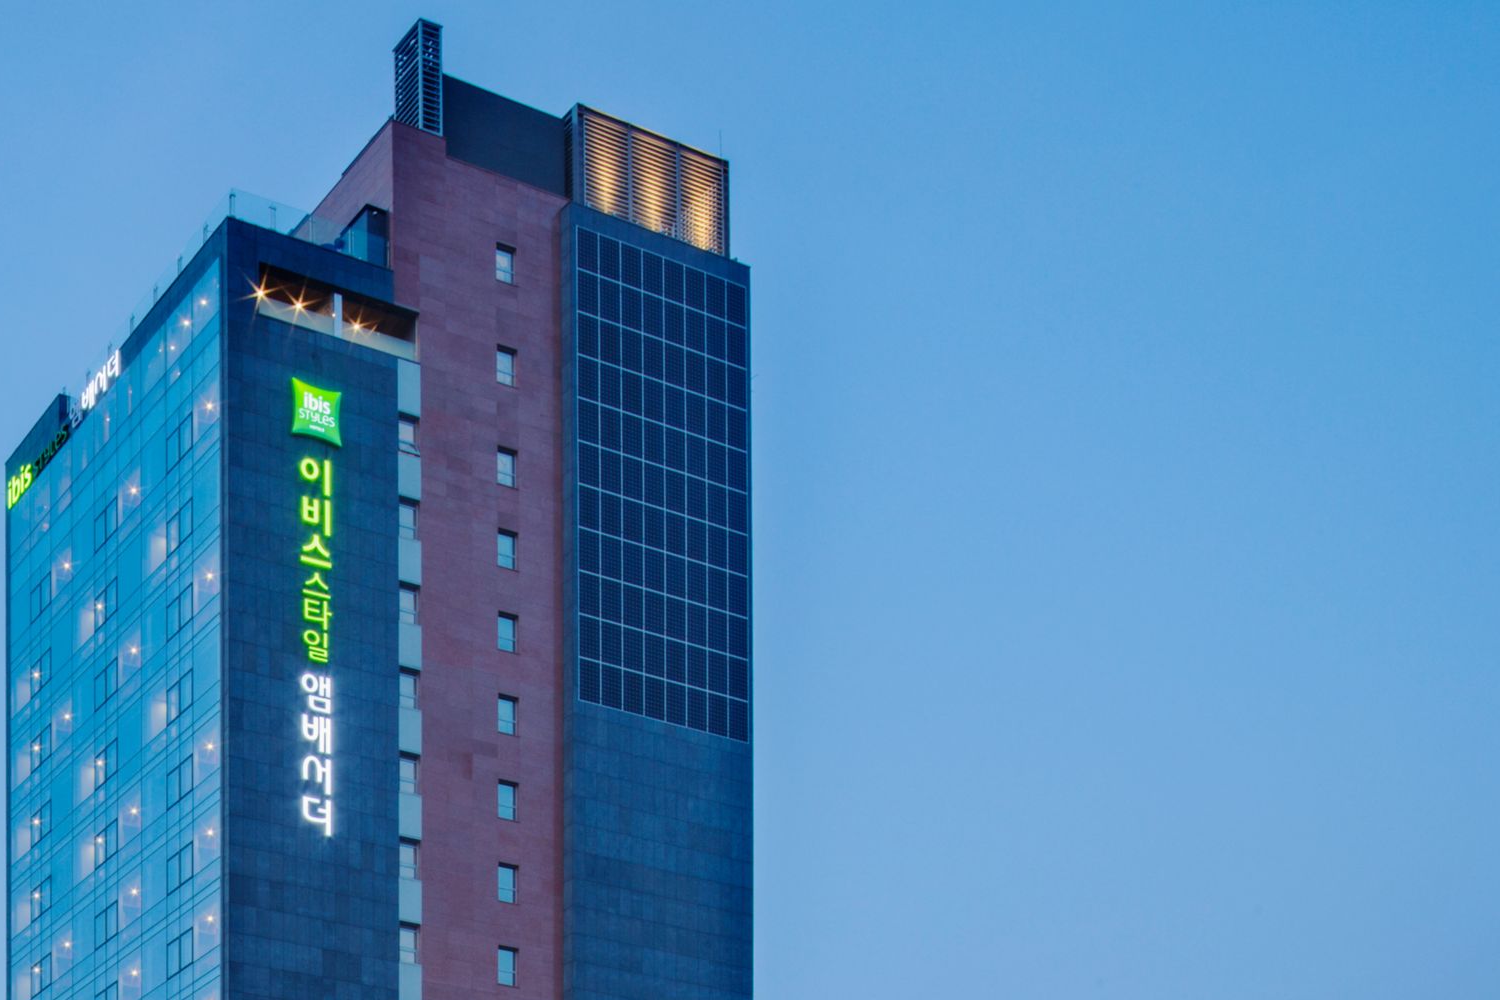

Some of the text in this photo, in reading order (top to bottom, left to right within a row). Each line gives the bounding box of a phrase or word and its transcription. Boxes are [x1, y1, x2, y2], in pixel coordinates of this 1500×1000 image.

[304, 391, 331, 415] ibis
[7, 464, 32, 510] ibis
[301, 673, 332, 837] 앰배서더
